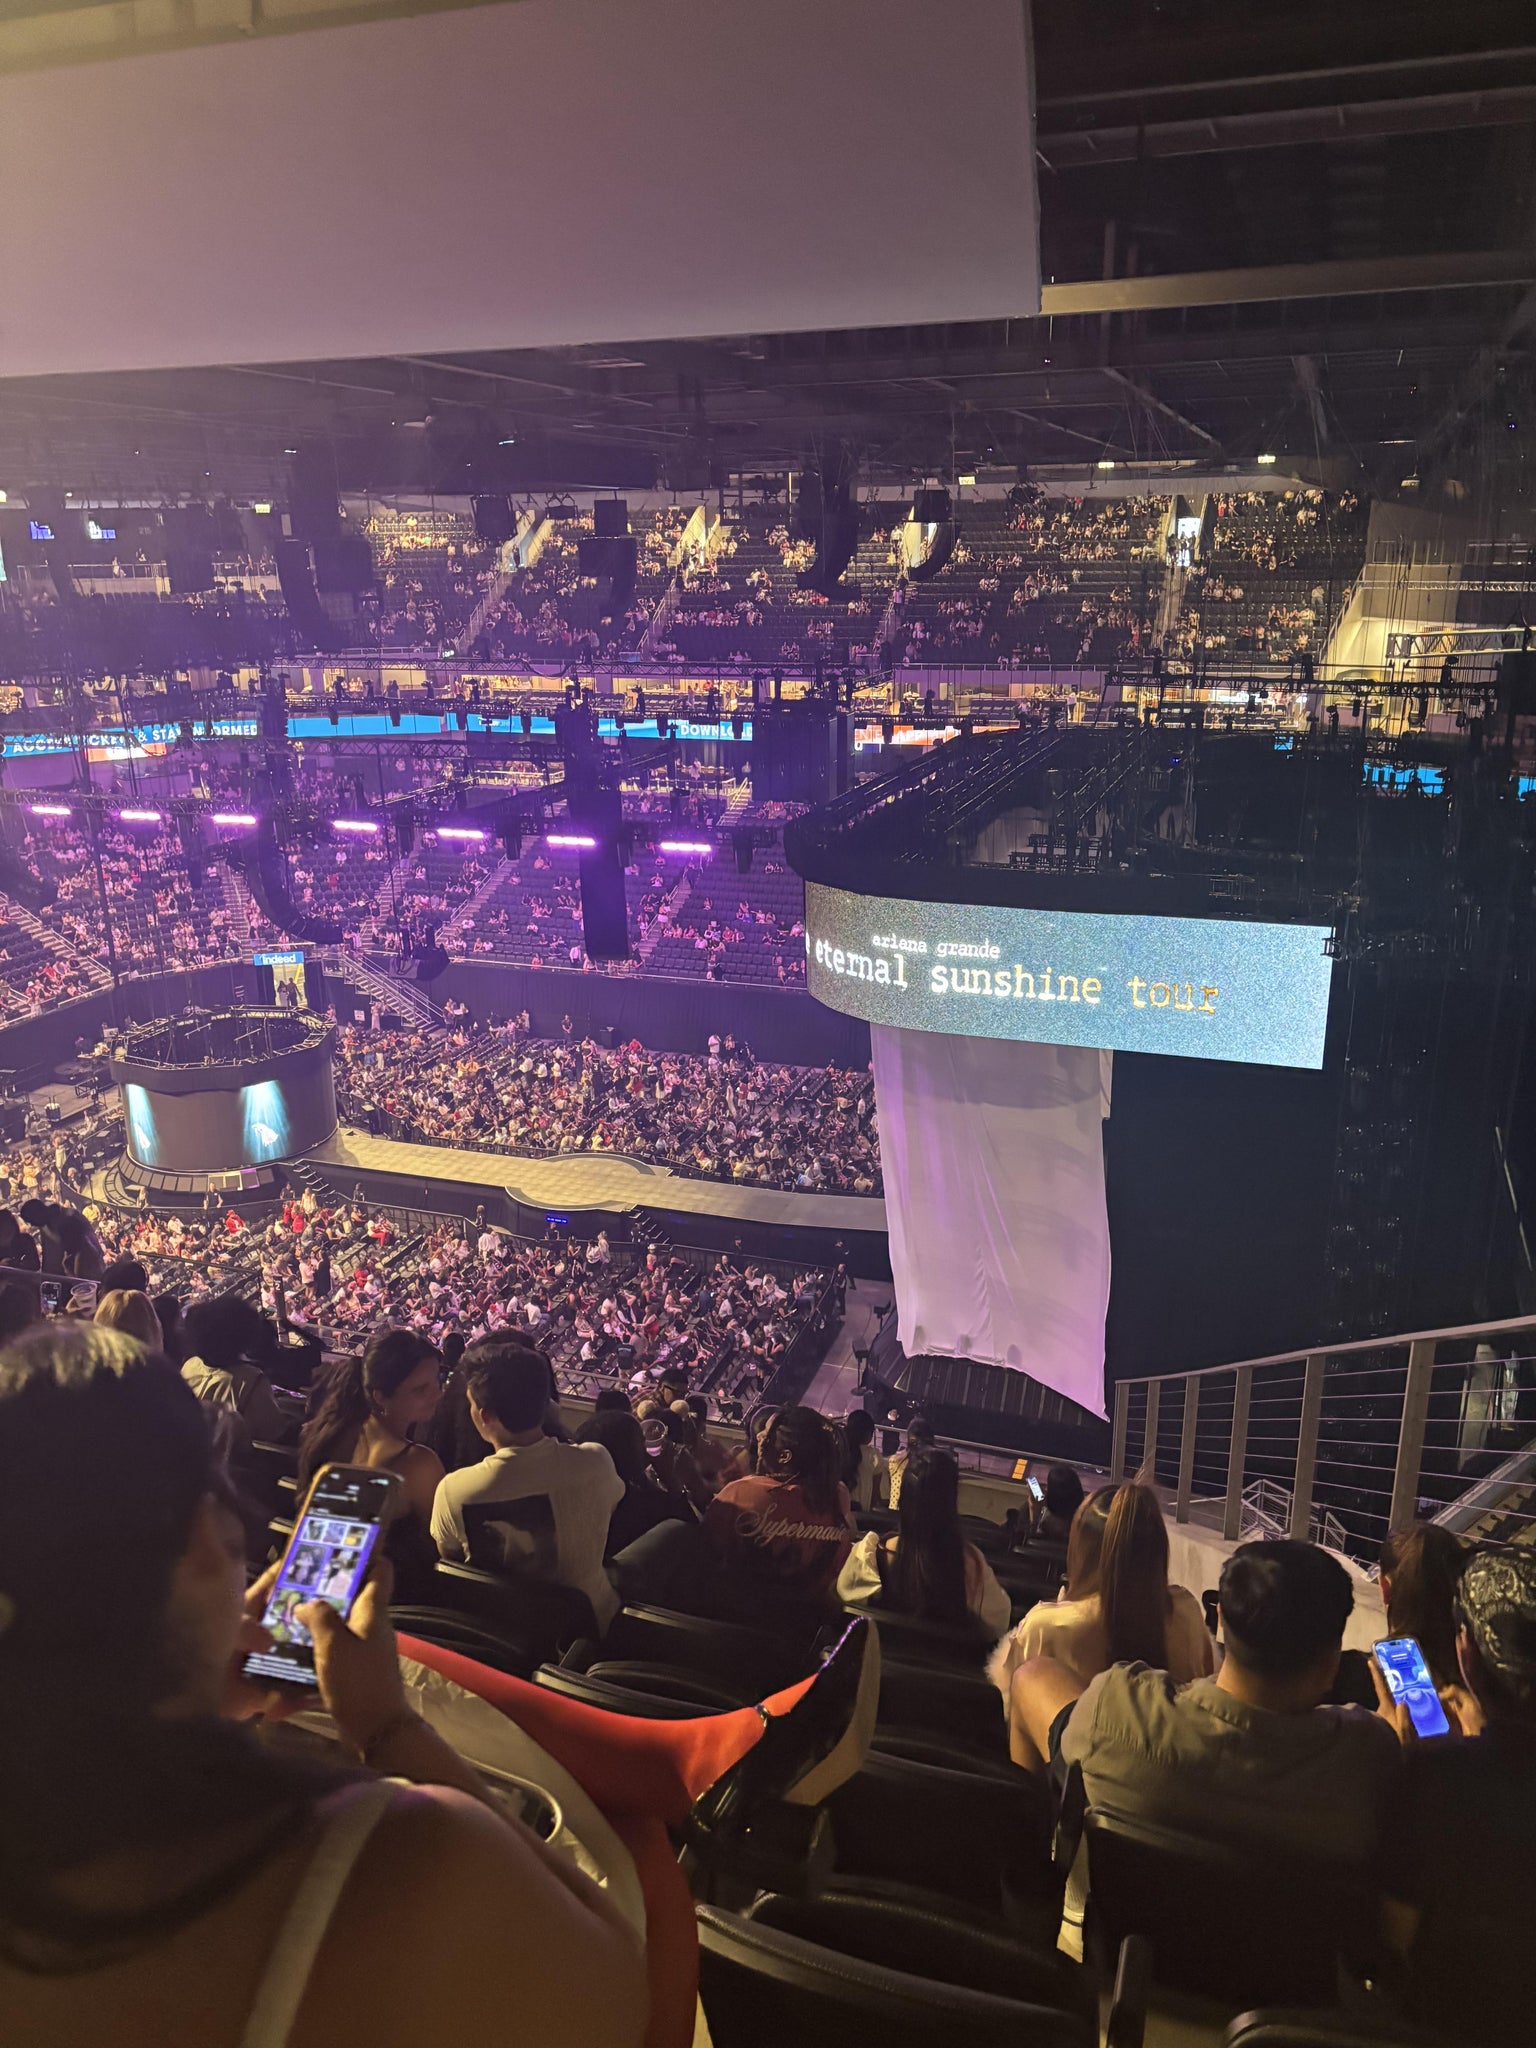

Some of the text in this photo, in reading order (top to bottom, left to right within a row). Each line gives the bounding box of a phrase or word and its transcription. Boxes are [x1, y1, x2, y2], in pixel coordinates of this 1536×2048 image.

[872, 933, 1001, 959] ariana grande
[262, 954, 296, 965] indeed
[815, 938, 909, 991] eternal
[930, 963, 1103, 1005] sunshine
[1127, 974, 1220, 1016] tour
